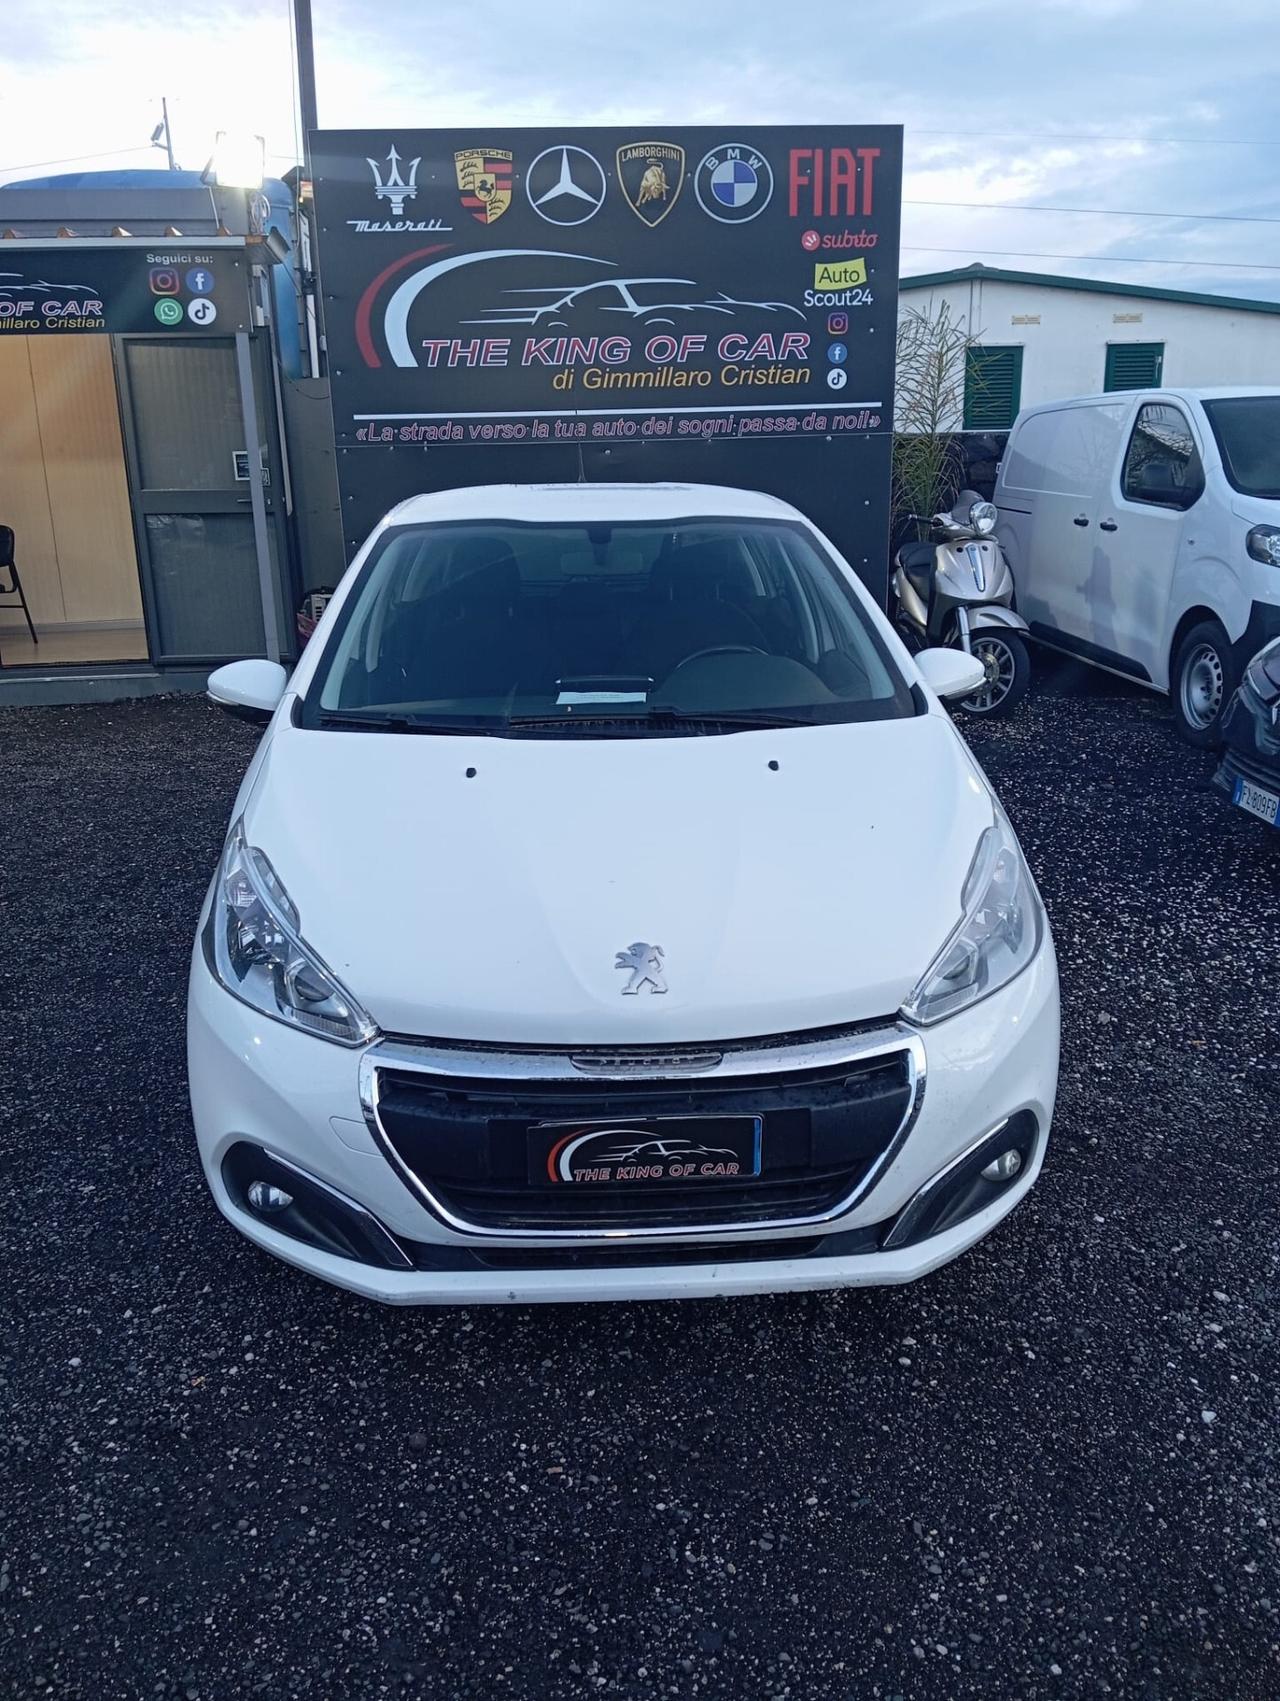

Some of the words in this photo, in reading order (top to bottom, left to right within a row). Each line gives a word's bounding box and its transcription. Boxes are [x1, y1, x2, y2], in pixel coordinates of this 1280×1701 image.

[454, 148, 512, 160] PORSCHE
[621, 145, 681, 162] LAMBORGHINI
[704, 147, 763, 170] BMW
[788, 147, 881, 217] FIAT
[346, 218, 453, 232] Maserati
[821, 229, 879, 248] subito
[146, 254, 192, 265] Seguici
[194, 254, 214, 264] su:
[818, 266, 860, 283] Auto
[803, 288, 874, 308] Scout24
[41, 300, 103, 316] CAR
[45, 316, 105, 328] Cristian
[422, 338, 511, 368] THE
[521, 336, 632, 366] KING
[645, 335, 707, 363] OF
[717, 333, 811, 361] CAR
[553, 369, 574, 390] di
[583, 367, 712, 388] Gimmillaro
[720, 364, 811, 386] Cristian
[399, 421, 464, 442] strada
[468, 424, 527, 440] verso
[531, 419, 549, 438] la
[554, 419, 587, 437] tua
[592, 418, 637, 436] auto
[641, 416, 674, 435] dei
[677, 415, 735, 437] sogni
[738, 416, 800, 436] passa
[802, 412, 827, 431] da
[573, 1168, 611, 1182] THE
[616, 1165, 663, 1180] KING
[668, 1164, 696, 1177] OF
[700, 1162, 740, 1176] CAR
